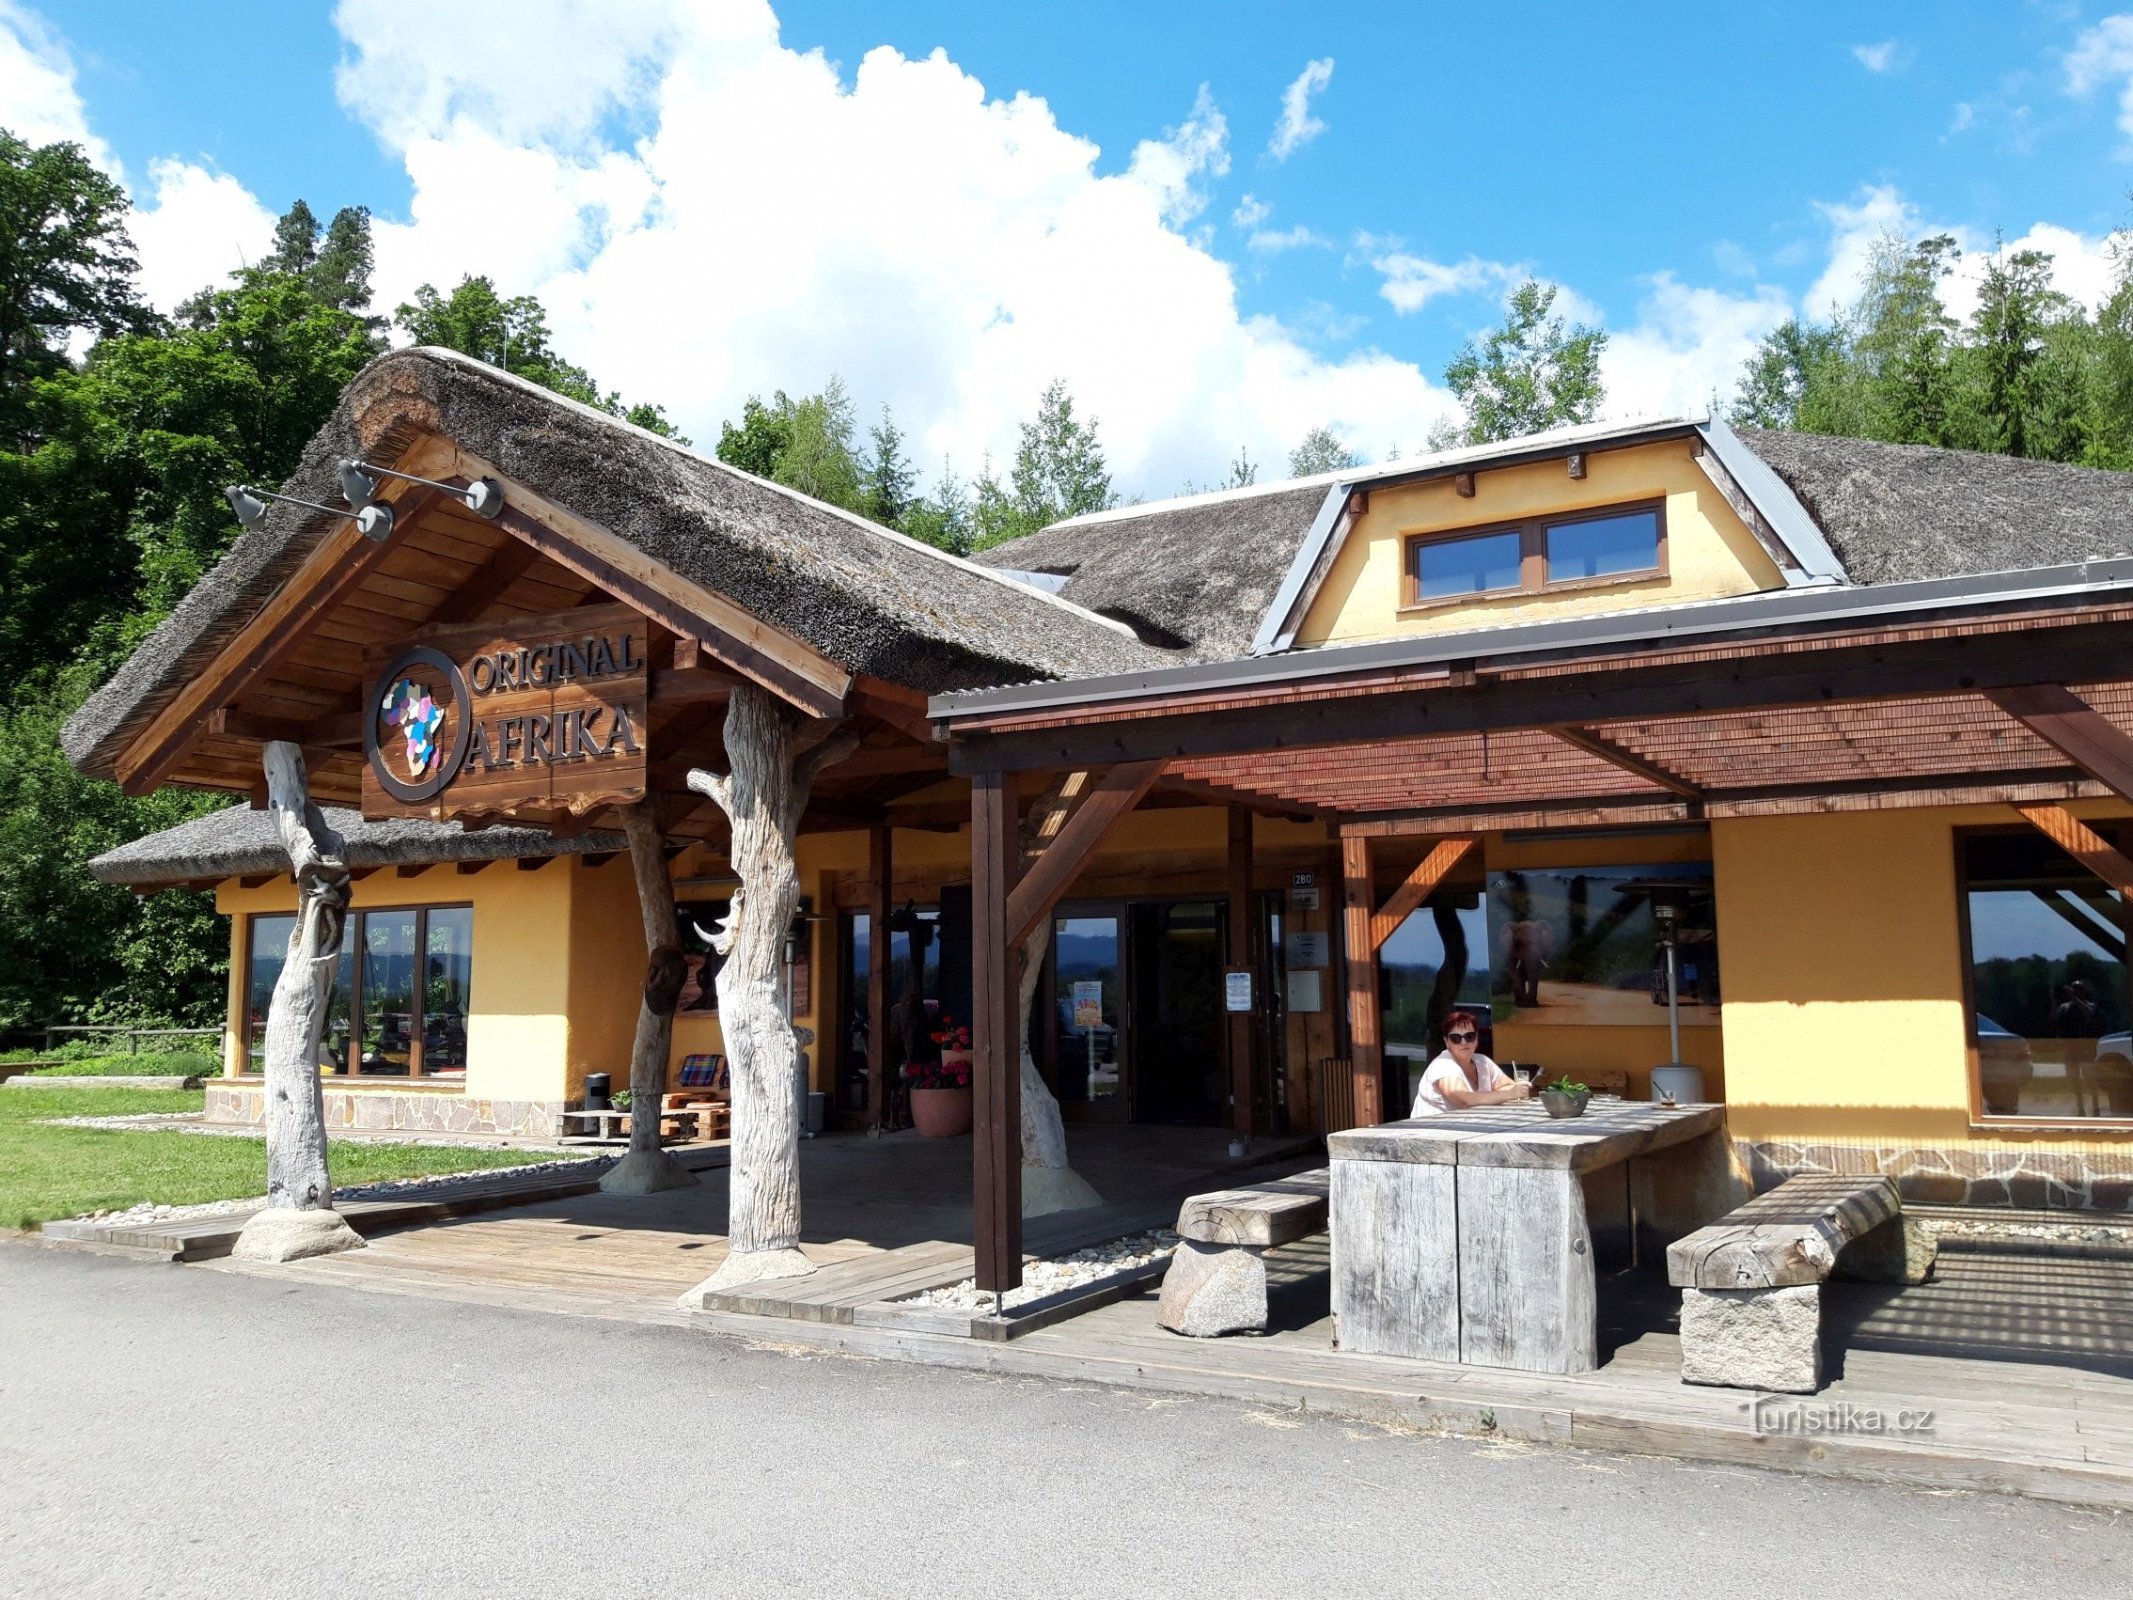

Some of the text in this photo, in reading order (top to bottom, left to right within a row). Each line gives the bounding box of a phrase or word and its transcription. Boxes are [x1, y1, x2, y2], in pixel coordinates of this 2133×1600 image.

[469, 634, 643, 696] ORIGINAL
[462, 703, 641, 771] AFRIKA
[1295, 874, 1312, 885] 280
